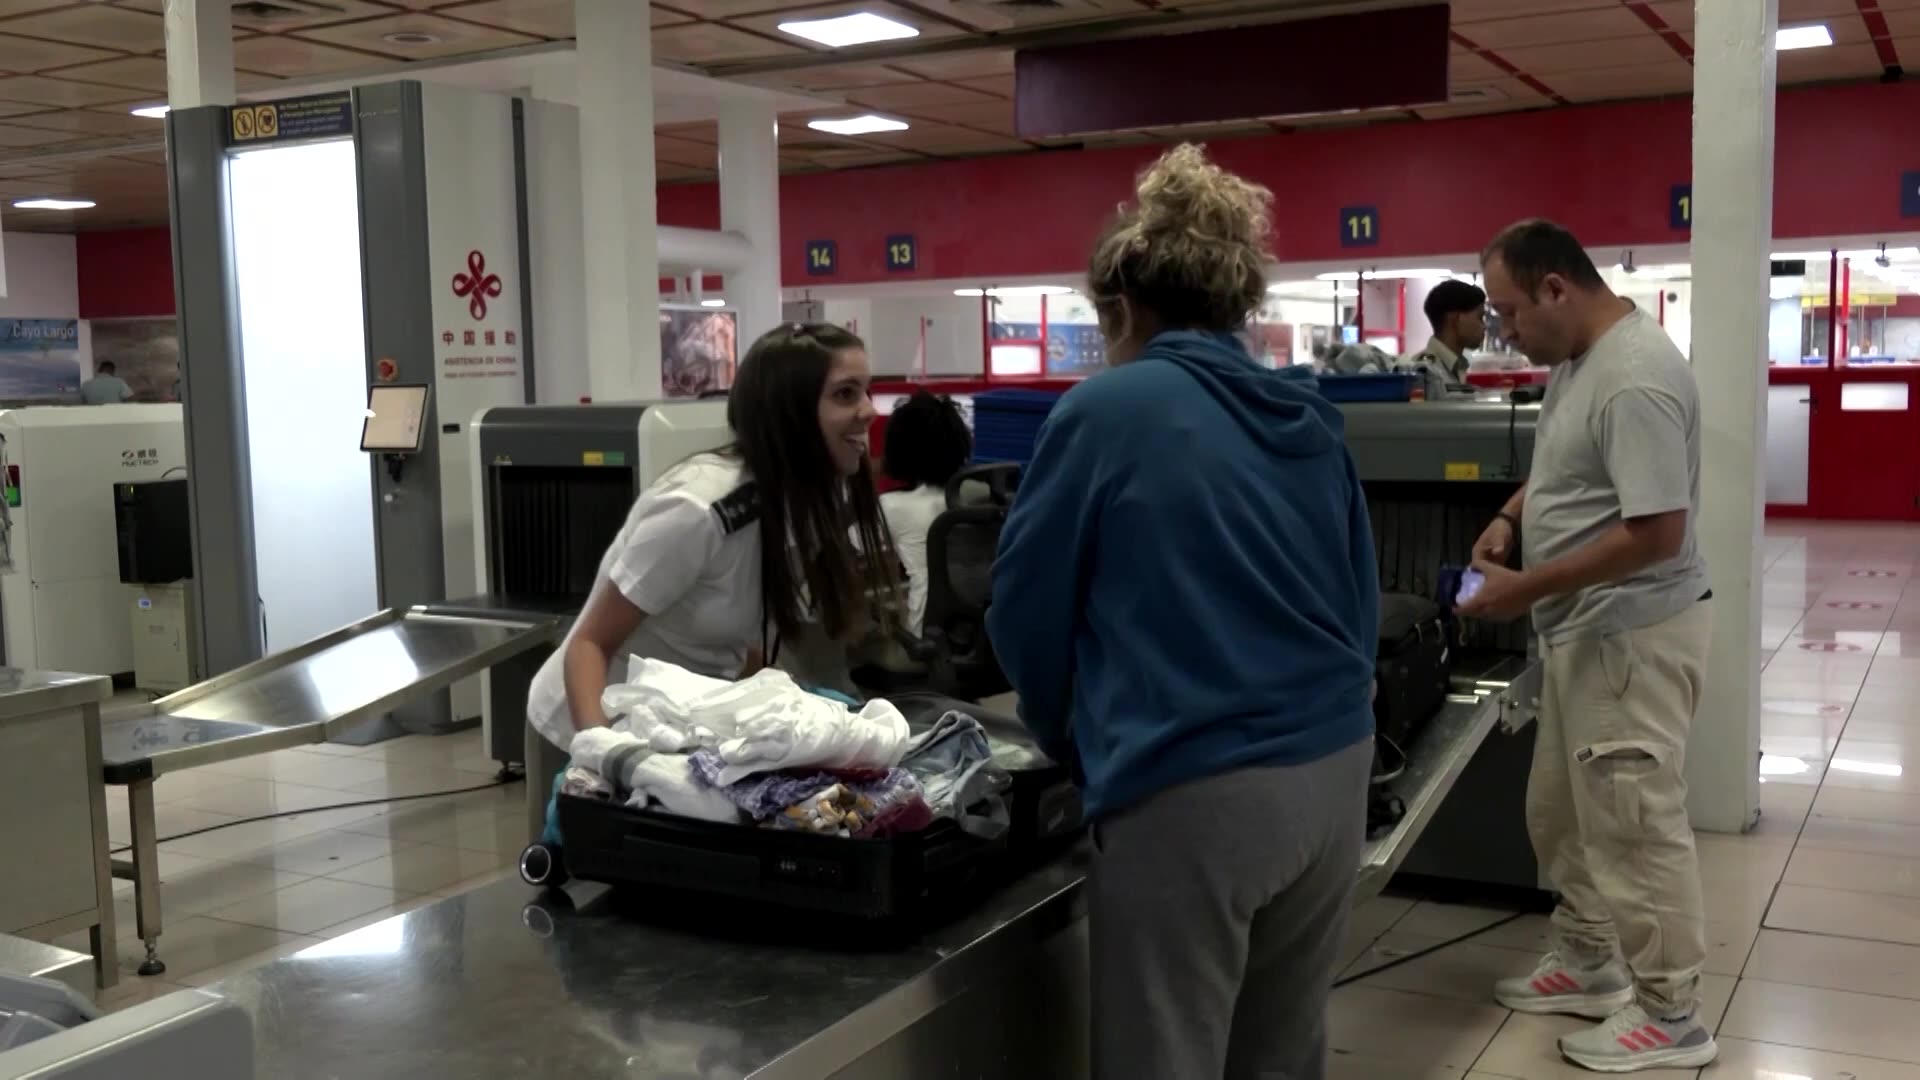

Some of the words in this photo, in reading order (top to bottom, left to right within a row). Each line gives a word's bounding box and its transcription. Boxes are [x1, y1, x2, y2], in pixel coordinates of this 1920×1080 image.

[1348, 215, 1371, 240] 11
[811, 247, 831, 268] 14
[890, 243, 911, 265] 13
[13, 322, 41, 340] Cayo
[44, 323, 74, 340] Largo
